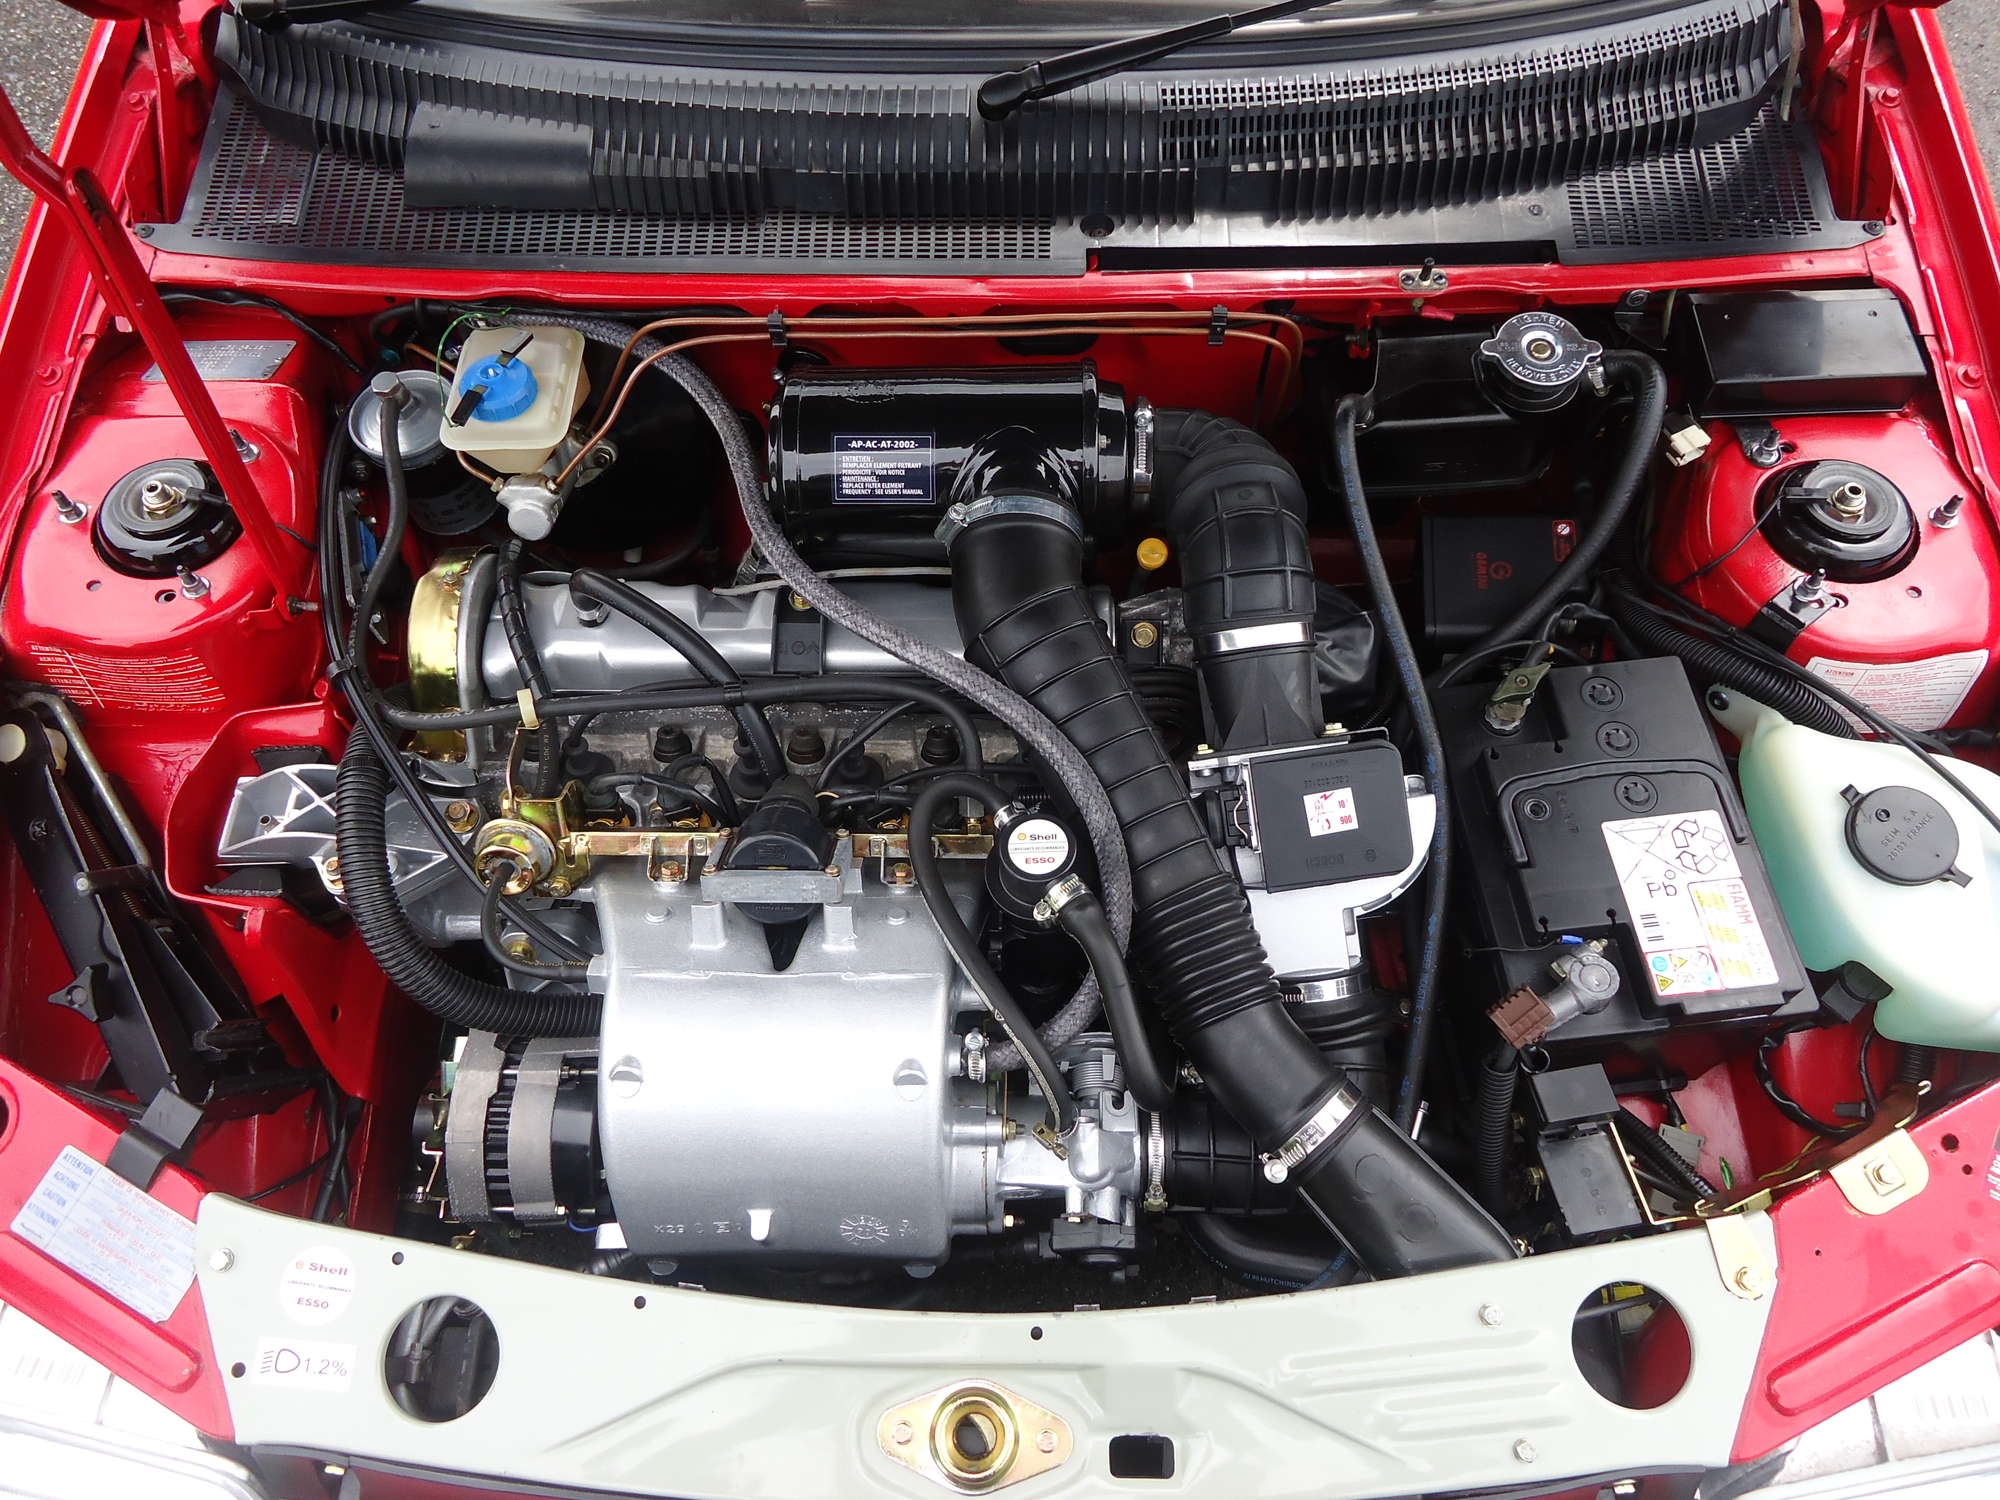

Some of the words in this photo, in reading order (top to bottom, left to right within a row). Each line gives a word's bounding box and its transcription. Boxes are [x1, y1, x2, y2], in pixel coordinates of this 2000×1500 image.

[1506, 358, 1546, 381] REMOVE
[1905, 812, 1935, 841] FRANCE
[1647, 881, 1677, 898] Pb
[1727, 883, 1753, 924] FIAMM
[308, 1261, 348, 1276] Shell
[296, 1296, 329, 1310] ESSO
[304, 1357, 348, 1377] 1.2%
